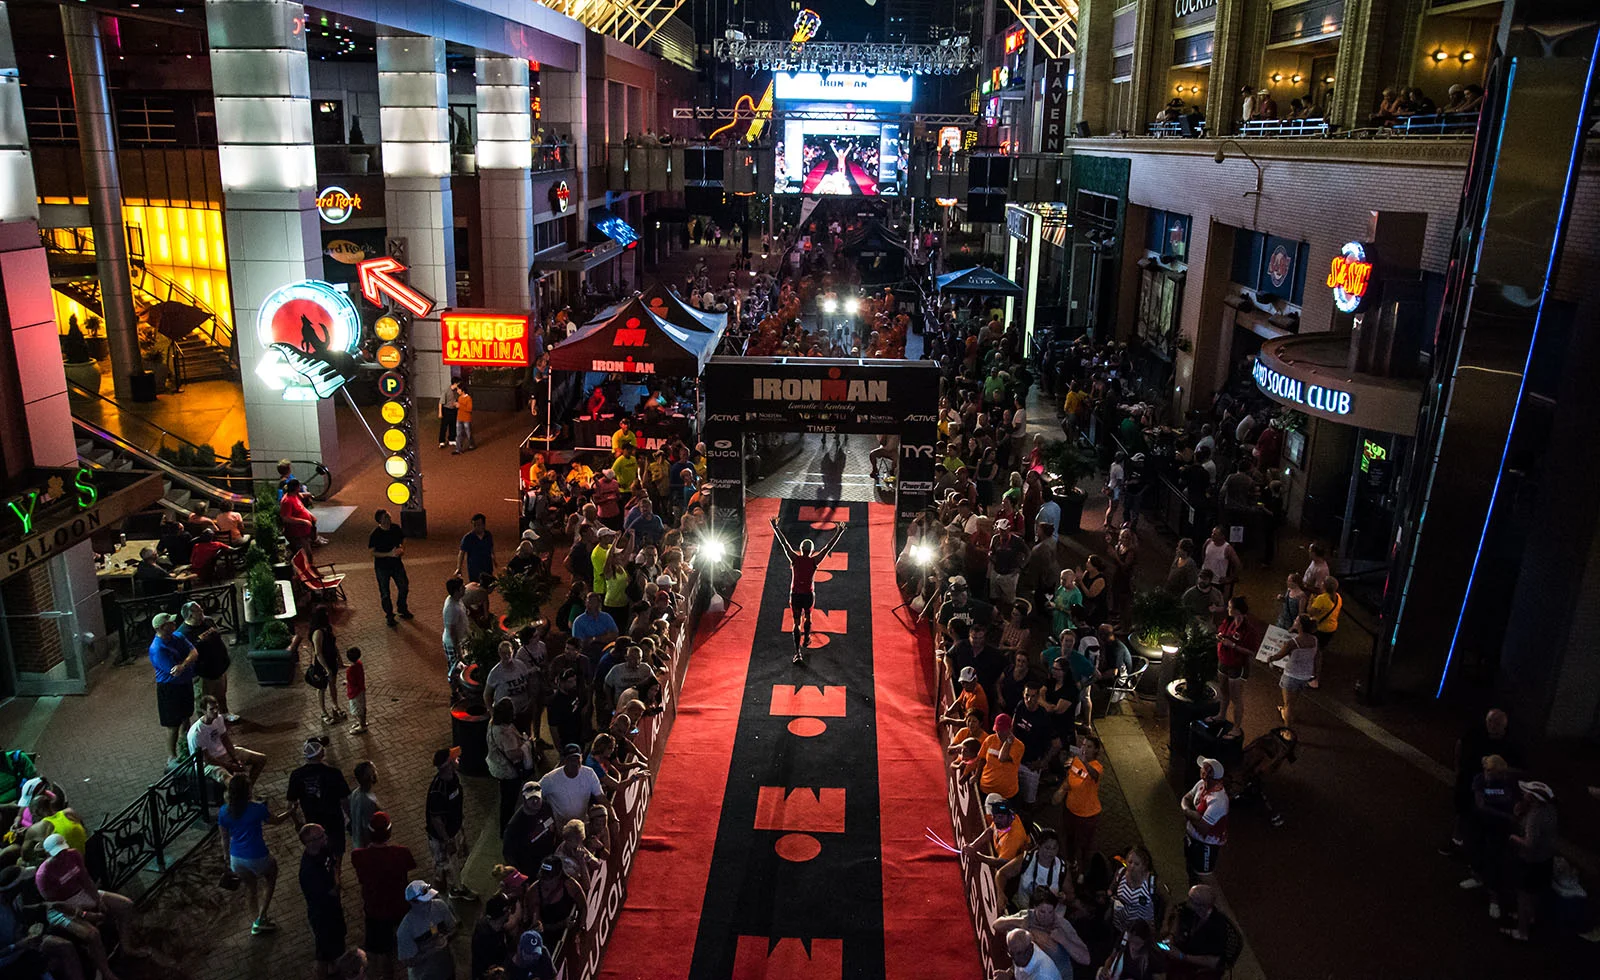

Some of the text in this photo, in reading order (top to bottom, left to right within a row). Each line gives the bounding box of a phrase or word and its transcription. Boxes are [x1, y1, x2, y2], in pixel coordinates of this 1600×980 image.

[820, 80, 867, 88] IRONAN
[1046, 61, 1063, 150] TAVERN
[335, 193, 362, 209] Rock
[446, 321, 505, 341] TENGO
[446, 341, 525, 360] CANTINA
[592, 358, 656, 374] IRONMAN
[753, 372, 888, 402] IRONMAN
[1267, 370, 1304, 404] SOCIAL
[1307, 385, 1351, 415] CLUB
[708, 414, 740, 422] ACTIVE
[904, 414, 937, 422] ACTIVE
[807, 425, 837, 433] TIMEX
[596, 434, 667, 450] IRMAN
[902, 444, 934, 458] TYR
[8, 509, 100, 572] SALOON
